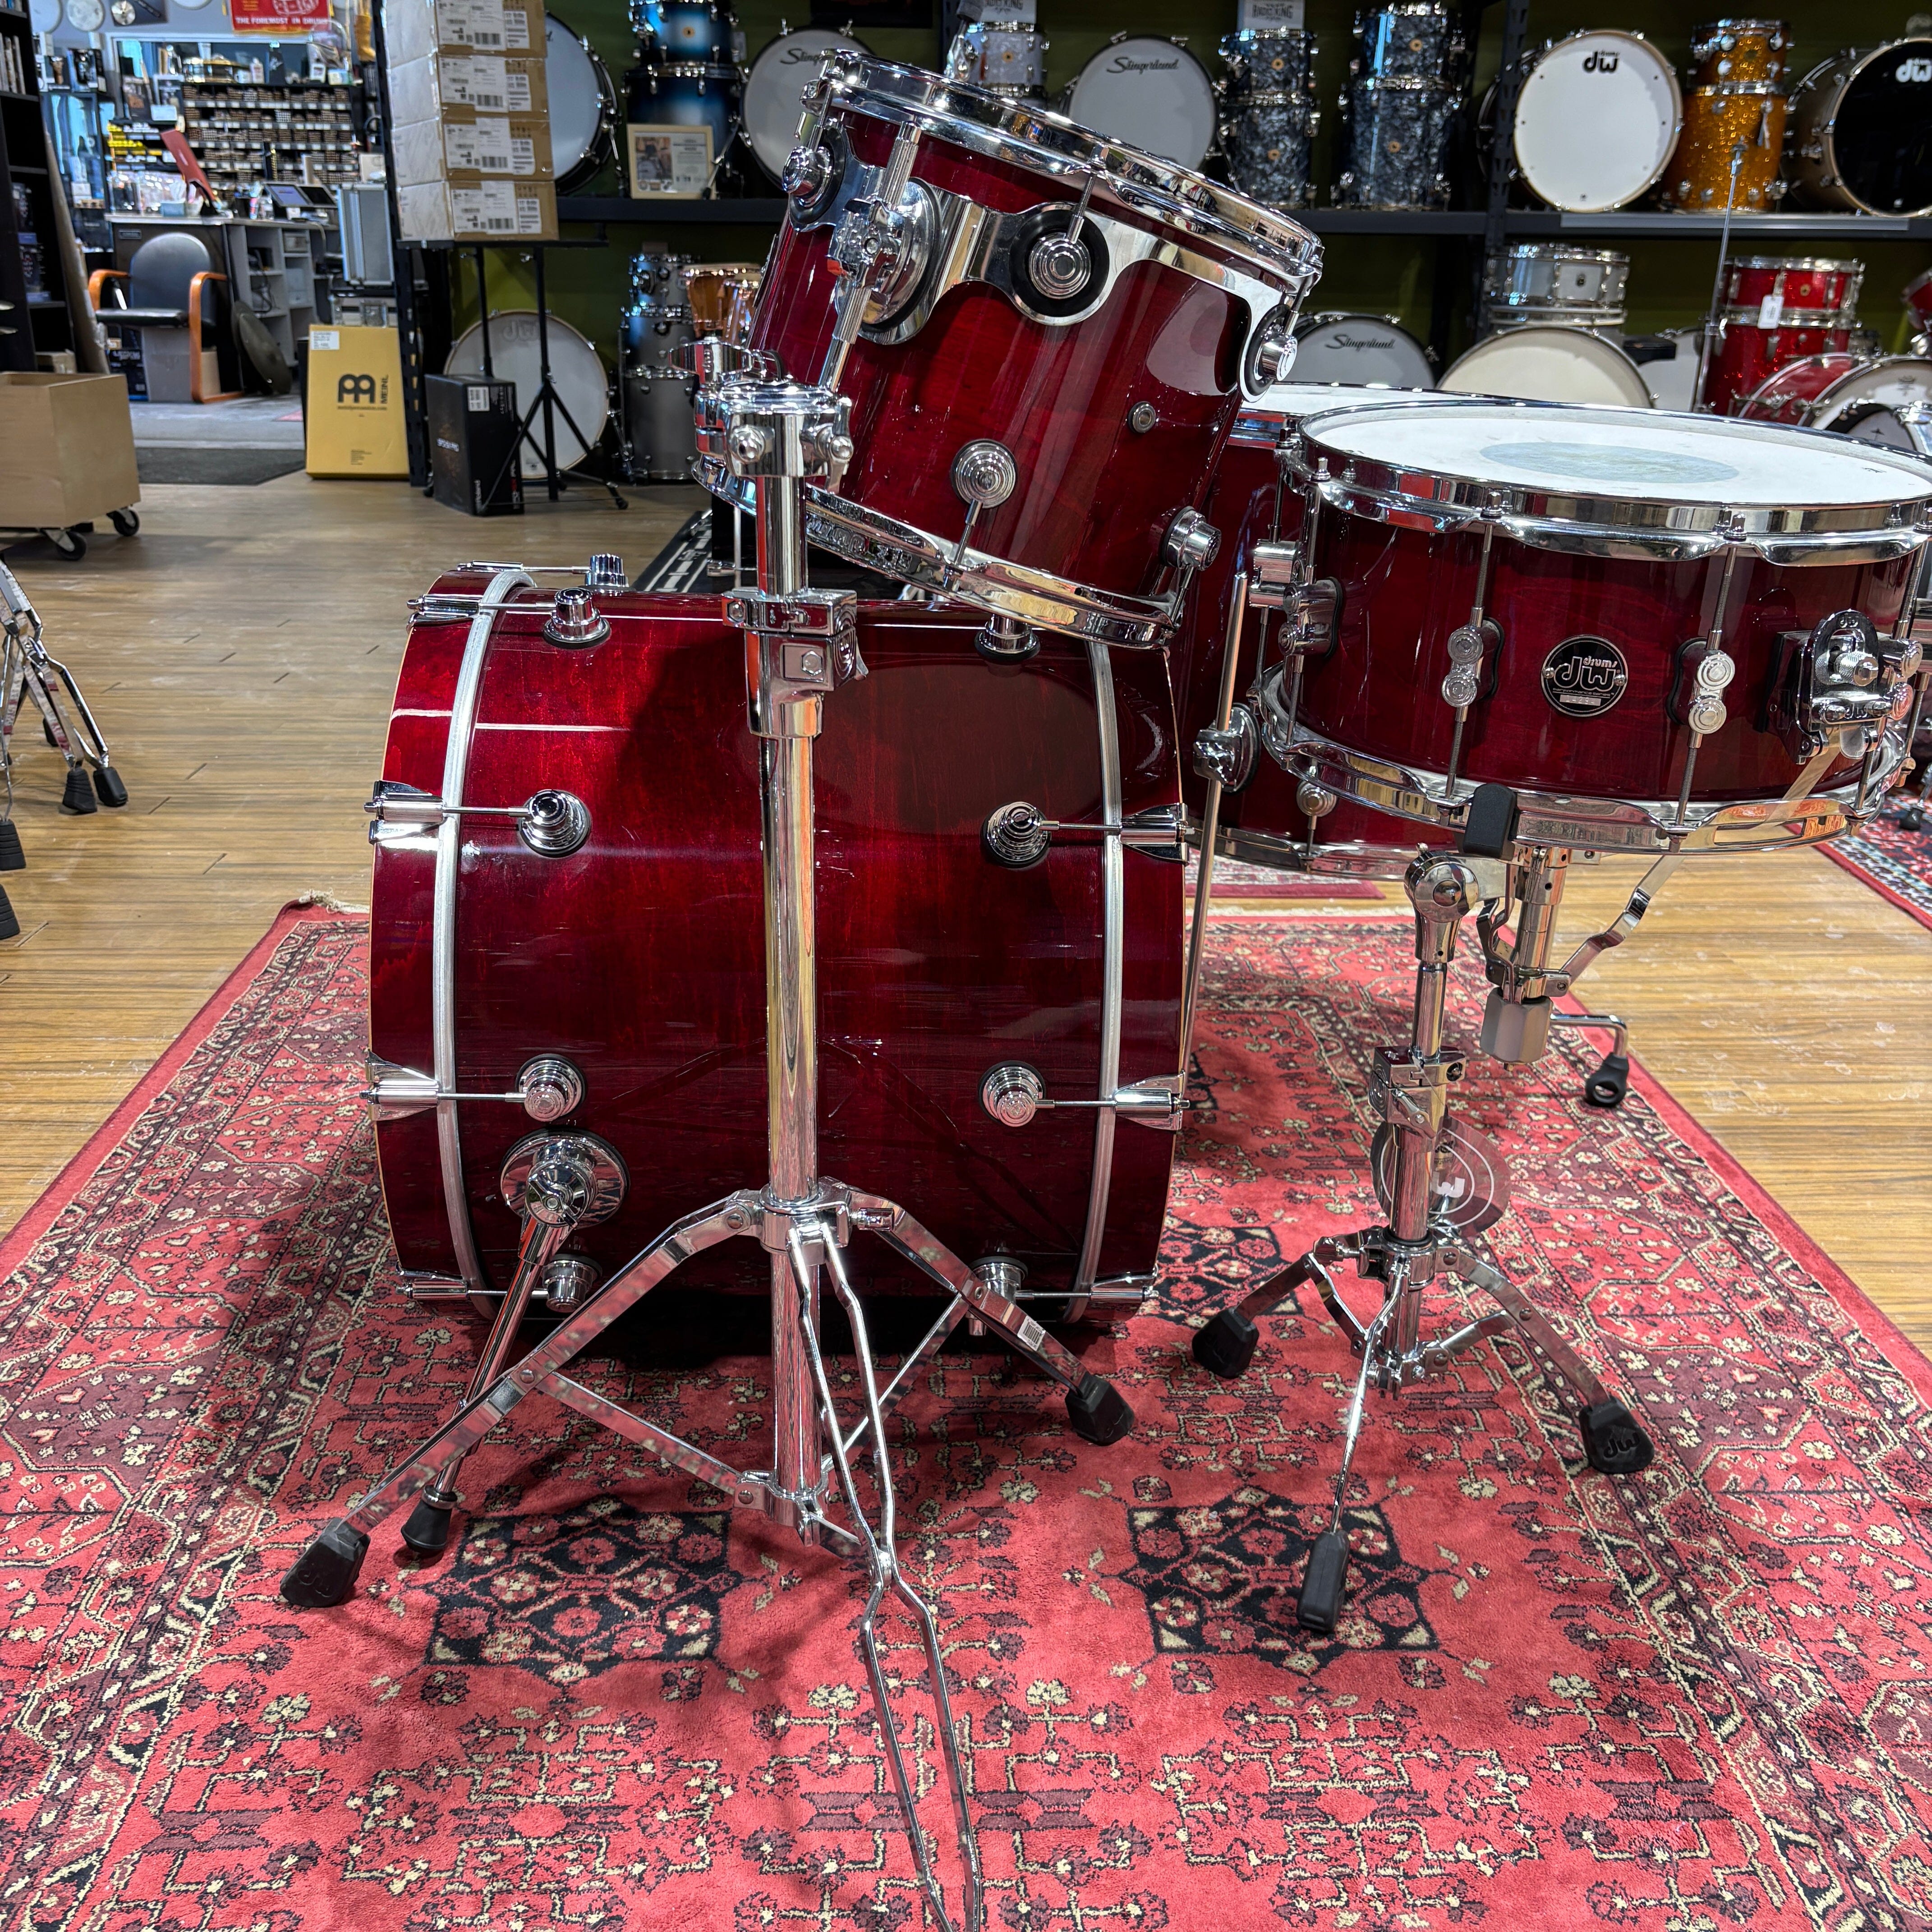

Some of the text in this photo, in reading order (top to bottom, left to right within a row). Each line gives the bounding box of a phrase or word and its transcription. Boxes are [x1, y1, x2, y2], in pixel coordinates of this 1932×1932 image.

[1106, 56, 1179, 75] Slingerland
[1582, 51, 1619, 74] dw
[1325, 333, 1395, 352] Slingerland
[381, 373, 390, 404] MEINL
[1554, 656, 1616, 692] dw
[1583, 656, 1618, 668] drums
[1431, 1171, 1466, 1198] w
[1603, 1432, 1640, 1458] dw
